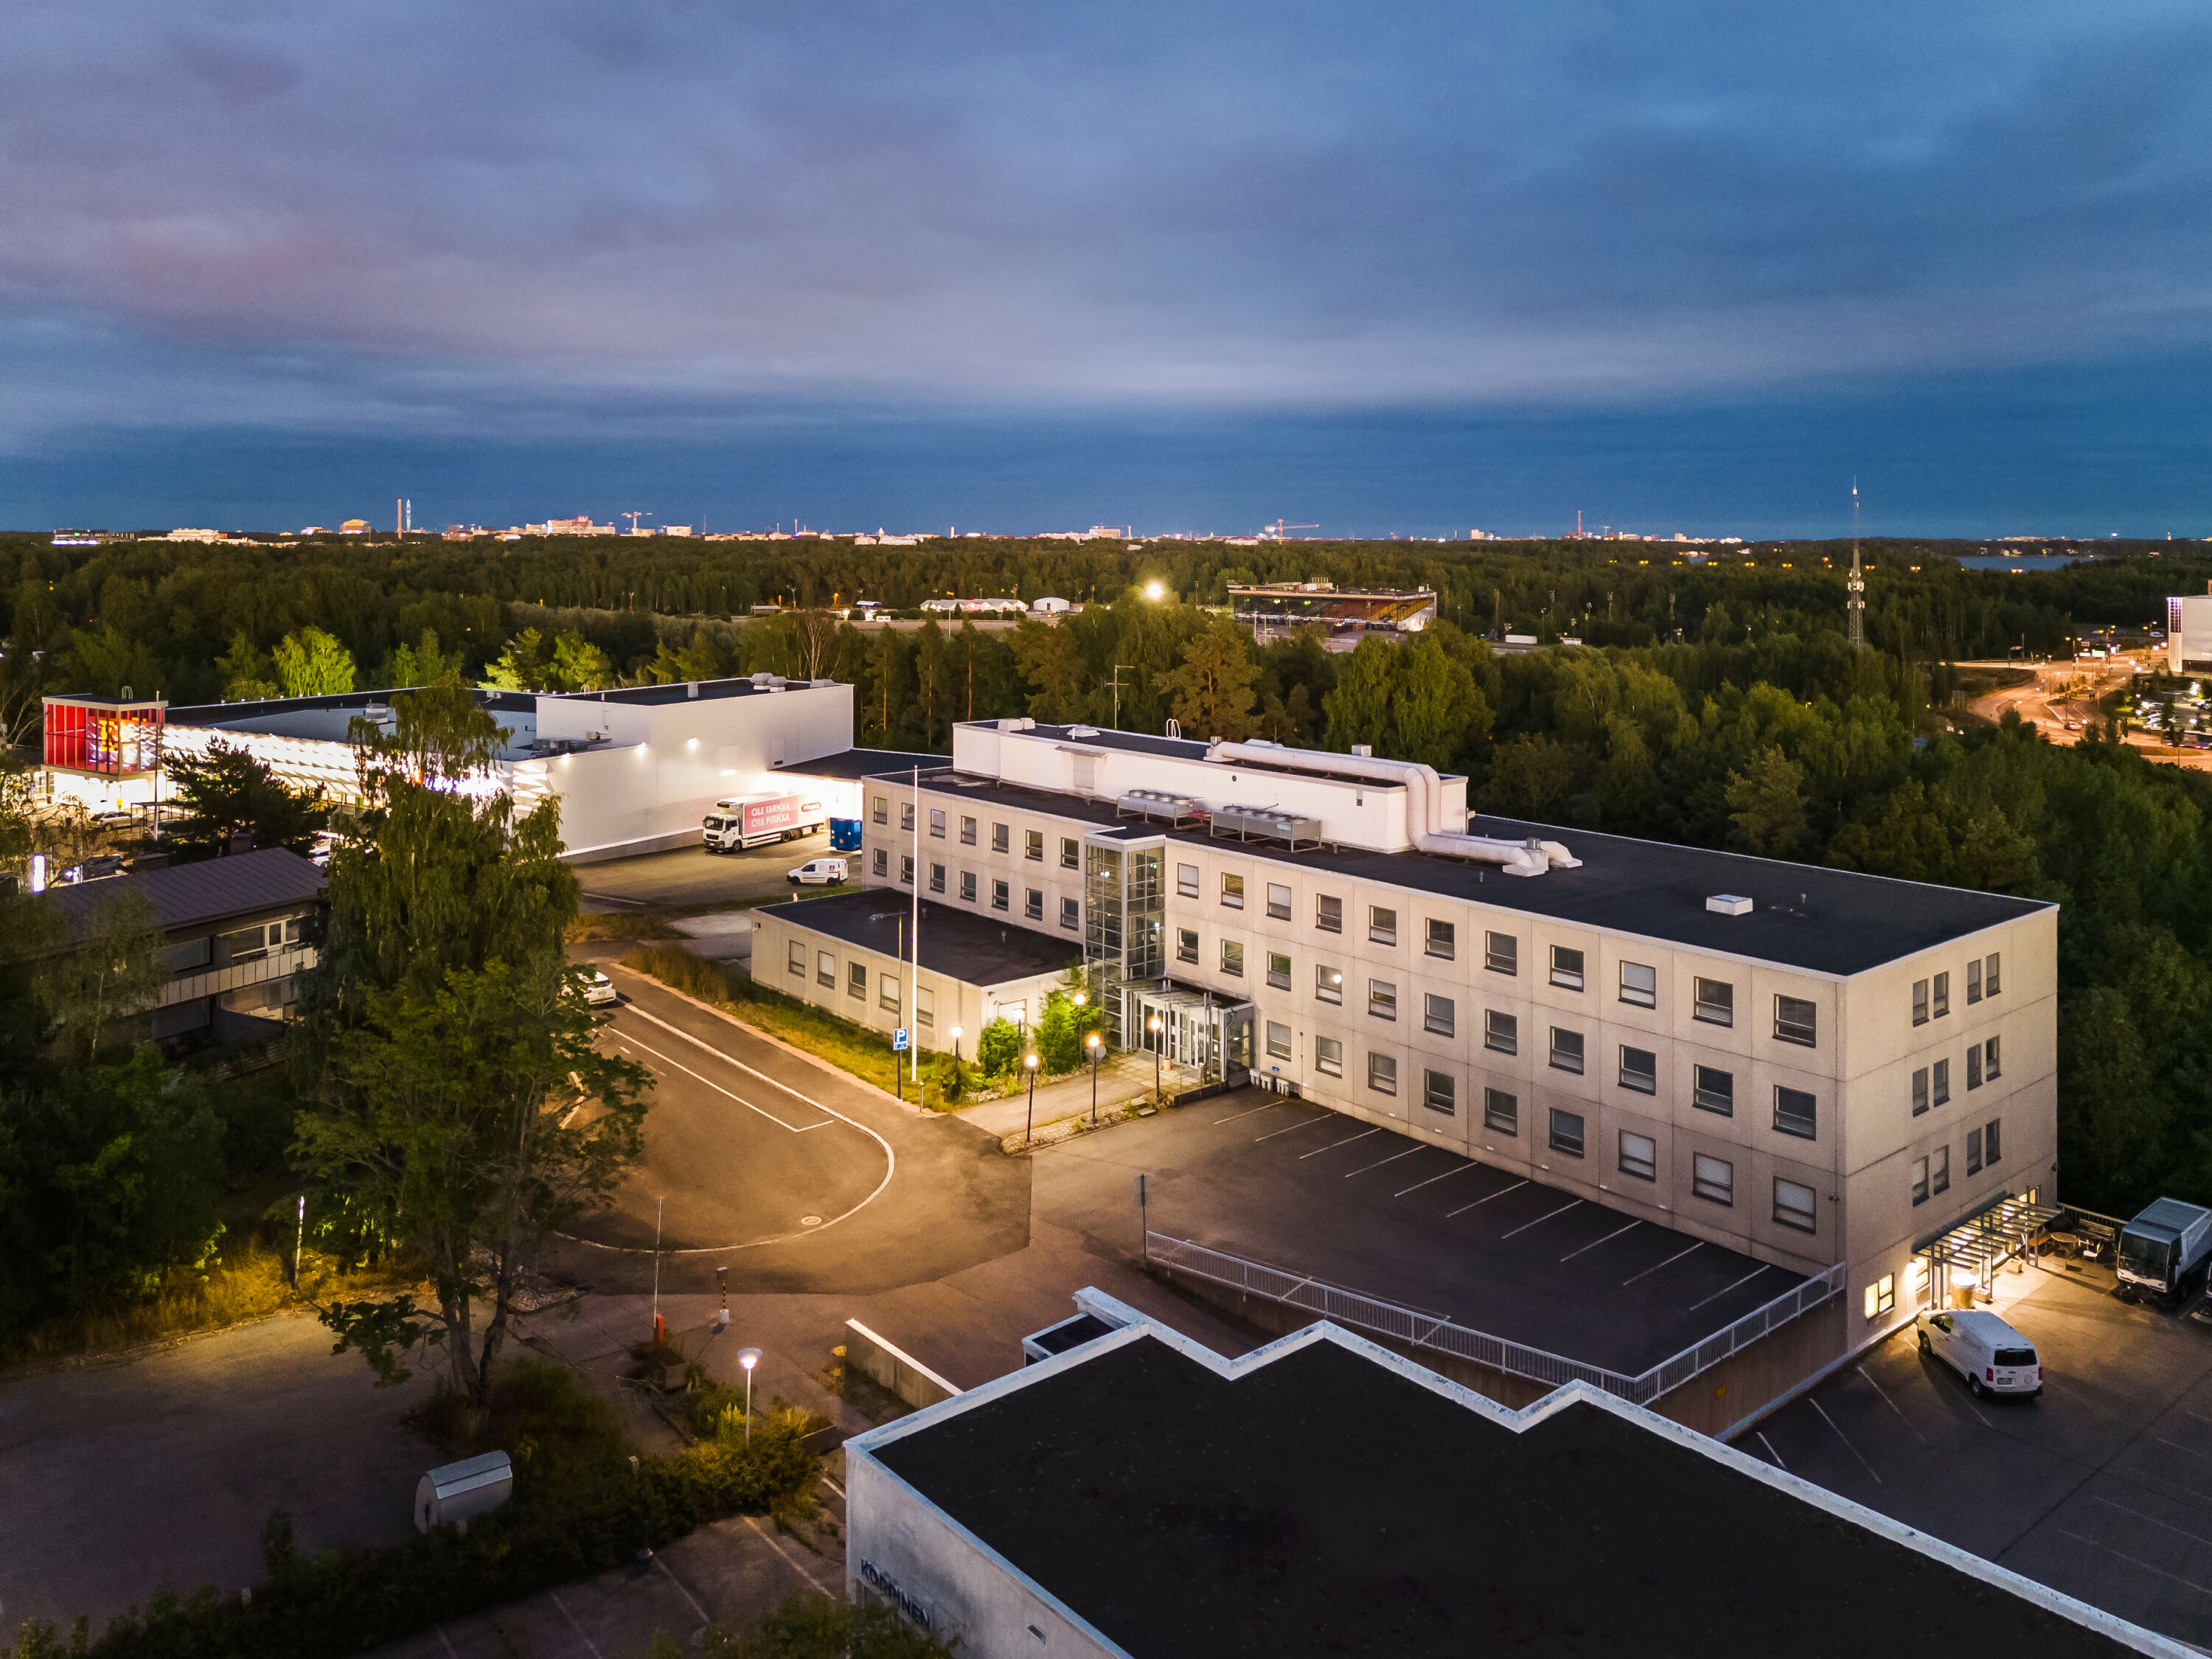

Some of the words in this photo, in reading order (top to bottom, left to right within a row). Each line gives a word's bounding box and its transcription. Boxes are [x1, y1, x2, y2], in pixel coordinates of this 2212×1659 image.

[751, 807, 764, 816] OLE
[751, 818, 764, 827] OTA
[897, 1029, 905, 1042] P
